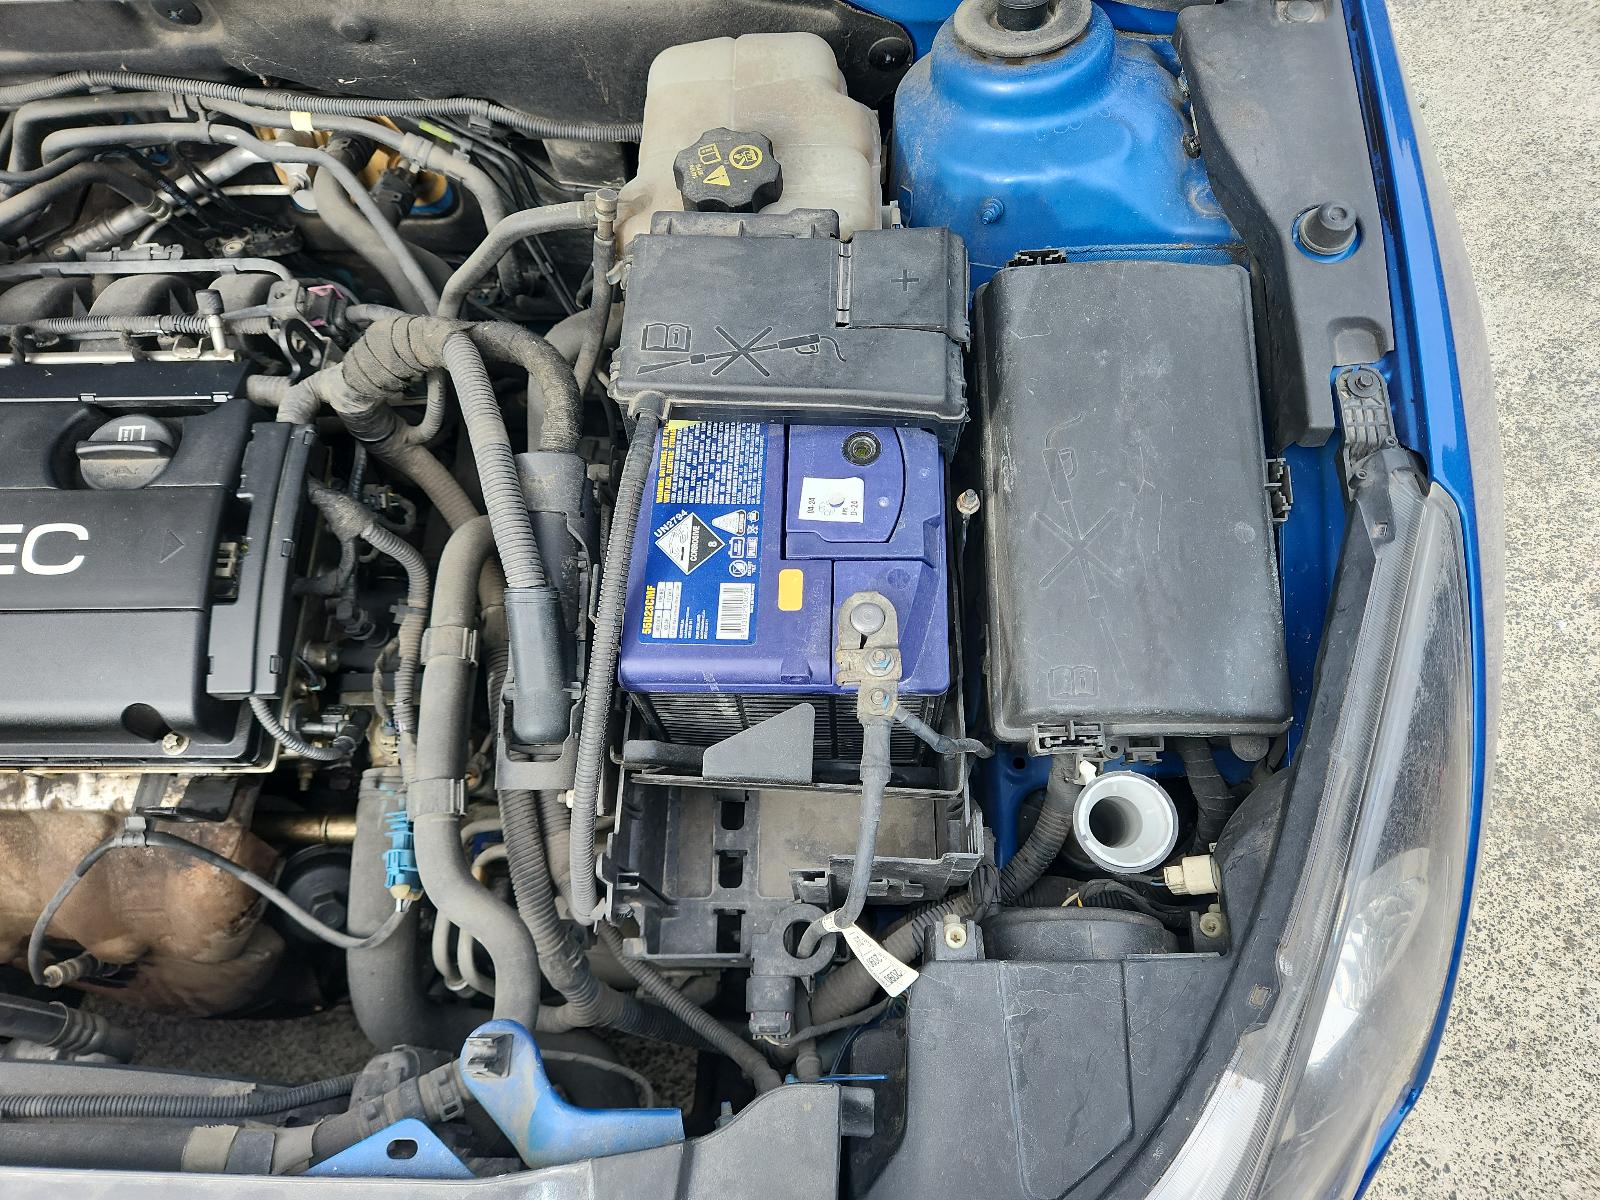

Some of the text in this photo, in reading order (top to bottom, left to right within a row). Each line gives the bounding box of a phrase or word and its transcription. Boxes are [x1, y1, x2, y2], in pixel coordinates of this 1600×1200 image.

[654, 509, 688, 537] UN2794
[690, 526, 700, 561] CORROSIVE
[642, 585, 656, 634] 55D23CMF
